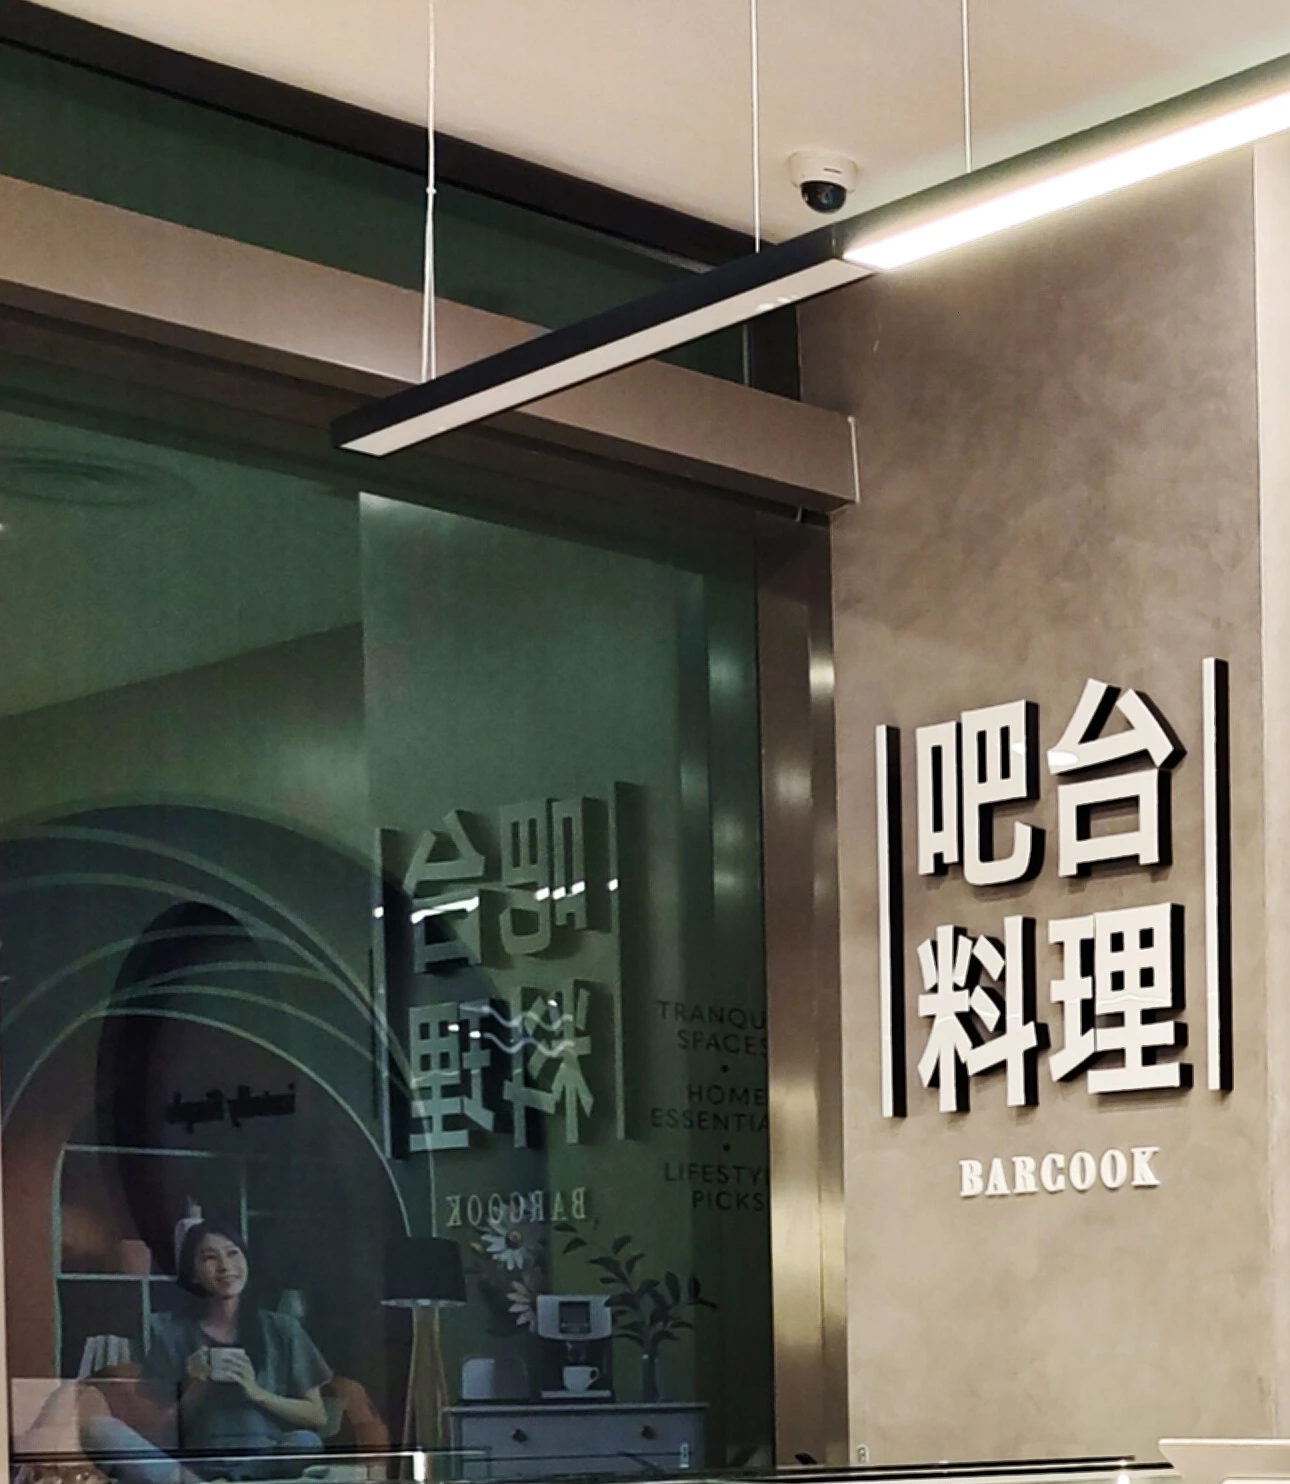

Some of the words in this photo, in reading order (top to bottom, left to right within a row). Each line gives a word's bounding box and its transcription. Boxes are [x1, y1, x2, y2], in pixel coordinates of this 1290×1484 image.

[916, 678, 1187, 886] 吧台
[917, 902, 1193, 1113] 料理
[688, 1084, 767, 1107] HOME
[959, 1146, 1161, 1198] BARCOOK
[692, 1189, 765, 1213] PICKS
